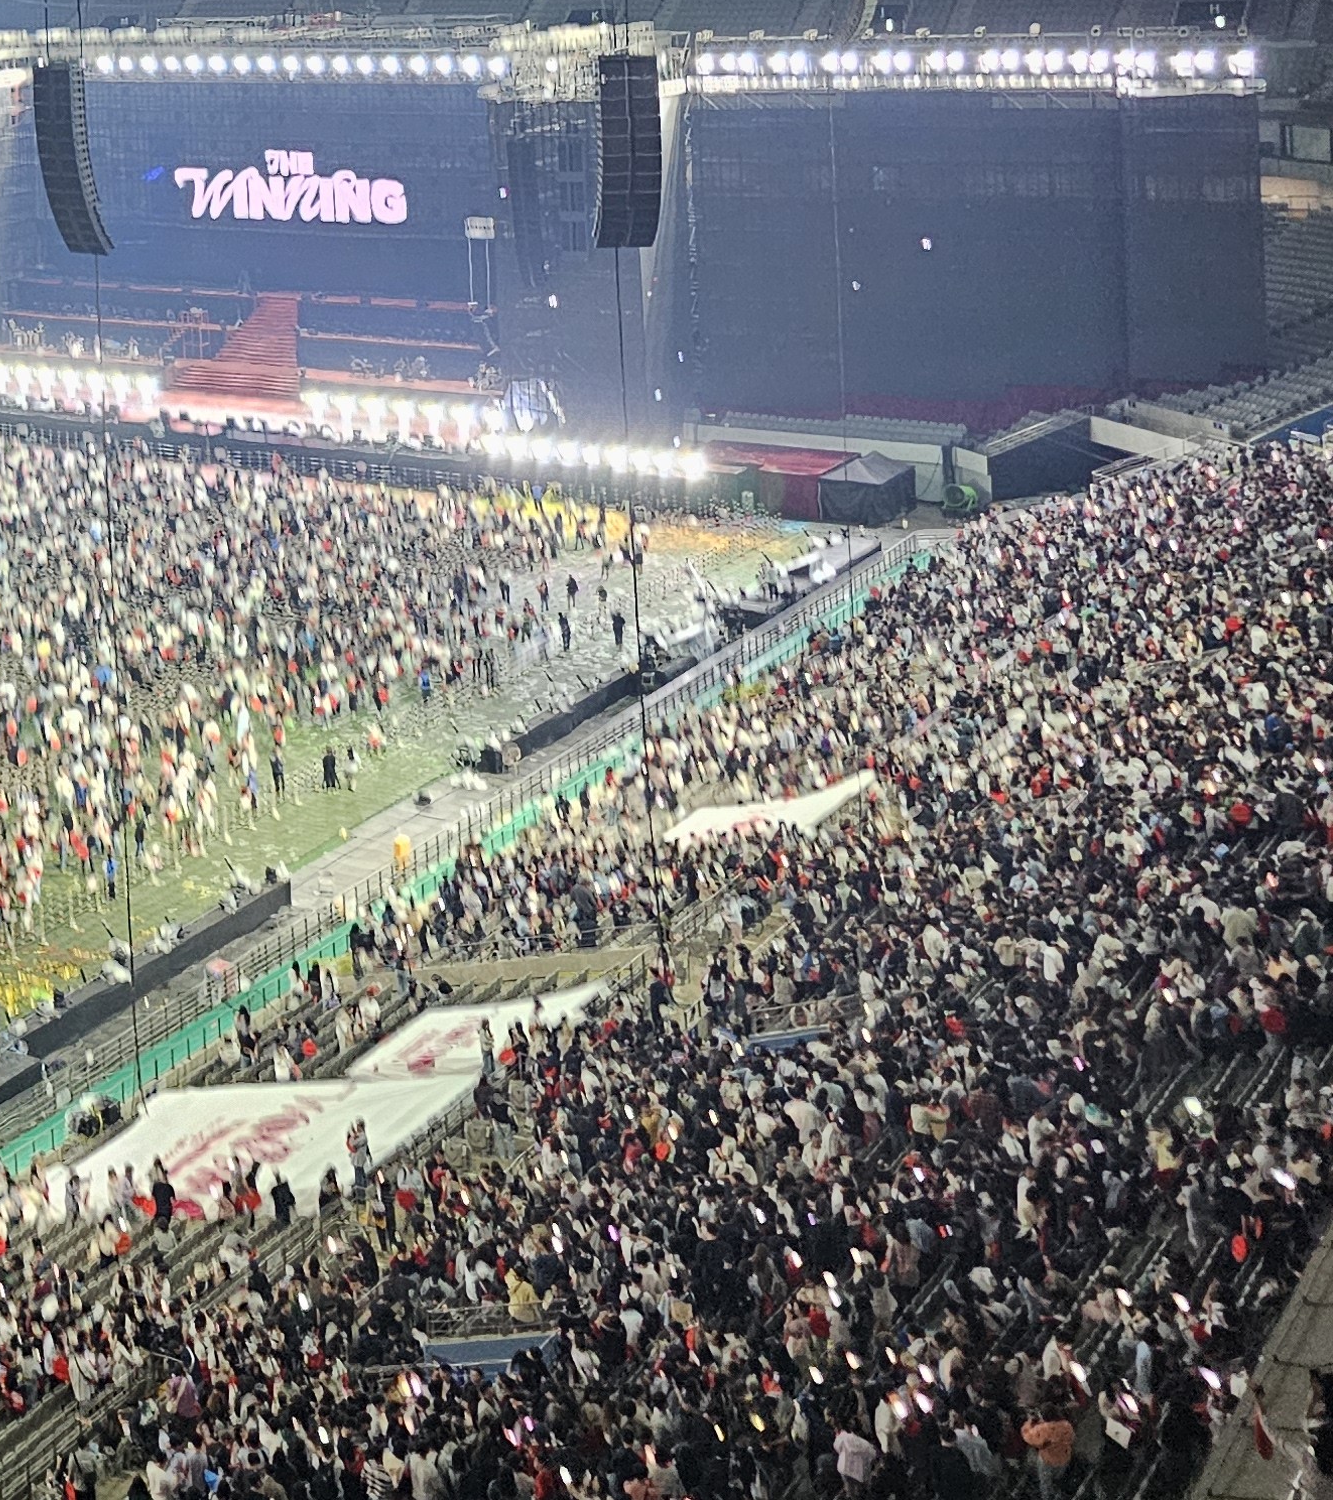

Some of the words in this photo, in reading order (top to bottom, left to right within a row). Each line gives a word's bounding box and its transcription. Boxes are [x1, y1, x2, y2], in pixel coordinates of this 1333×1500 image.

[591, 10, 599, 21] K
[264, 149, 314, 176] THE
[174, 166, 407, 224] WINNING
